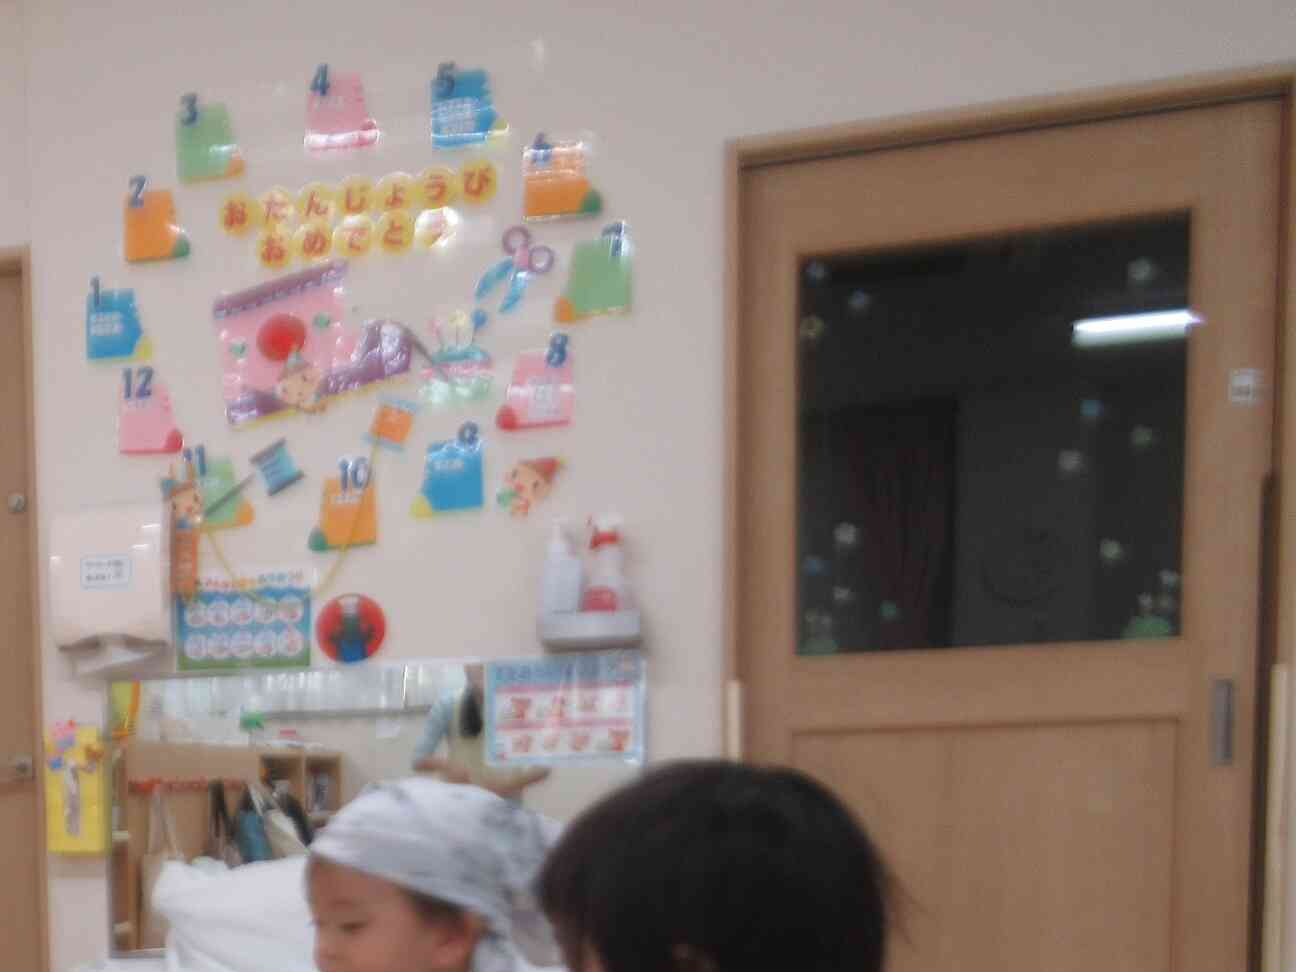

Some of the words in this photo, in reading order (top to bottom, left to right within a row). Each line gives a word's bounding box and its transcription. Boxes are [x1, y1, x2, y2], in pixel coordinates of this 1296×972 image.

[310, 64, 331, 96] 4
[436, 63, 456, 99] 5
[180, 94, 199, 127] 3
[128, 175, 147, 209] 2
[90, 276, 101, 308] 1
[547, 333, 569, 369] 8
[123, 367, 153, 399] 12
[338, 455, 370, 492] 10
